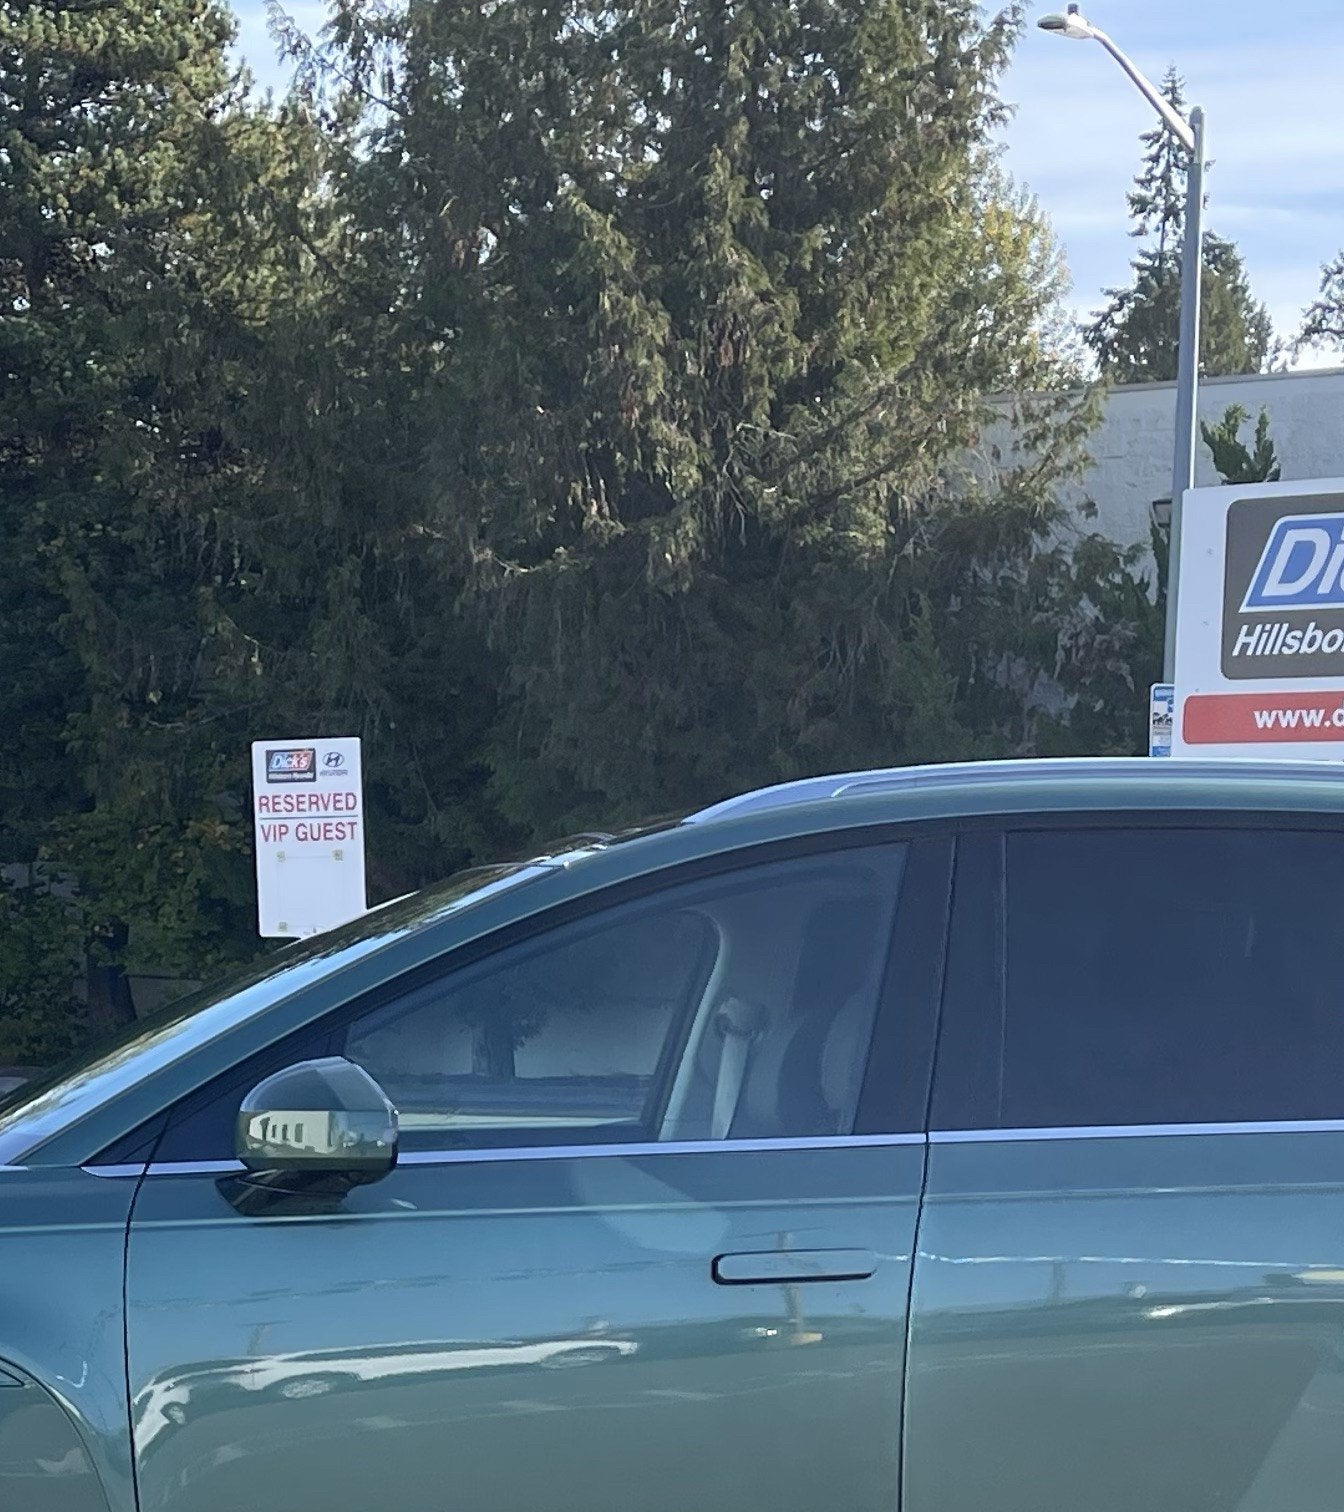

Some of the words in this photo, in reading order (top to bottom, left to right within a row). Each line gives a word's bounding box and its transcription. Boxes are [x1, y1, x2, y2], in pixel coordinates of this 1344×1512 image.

[258, 791, 358, 814] RESERVED
[260, 823, 290, 843] VIP
[295, 821, 358, 842] GUEST
